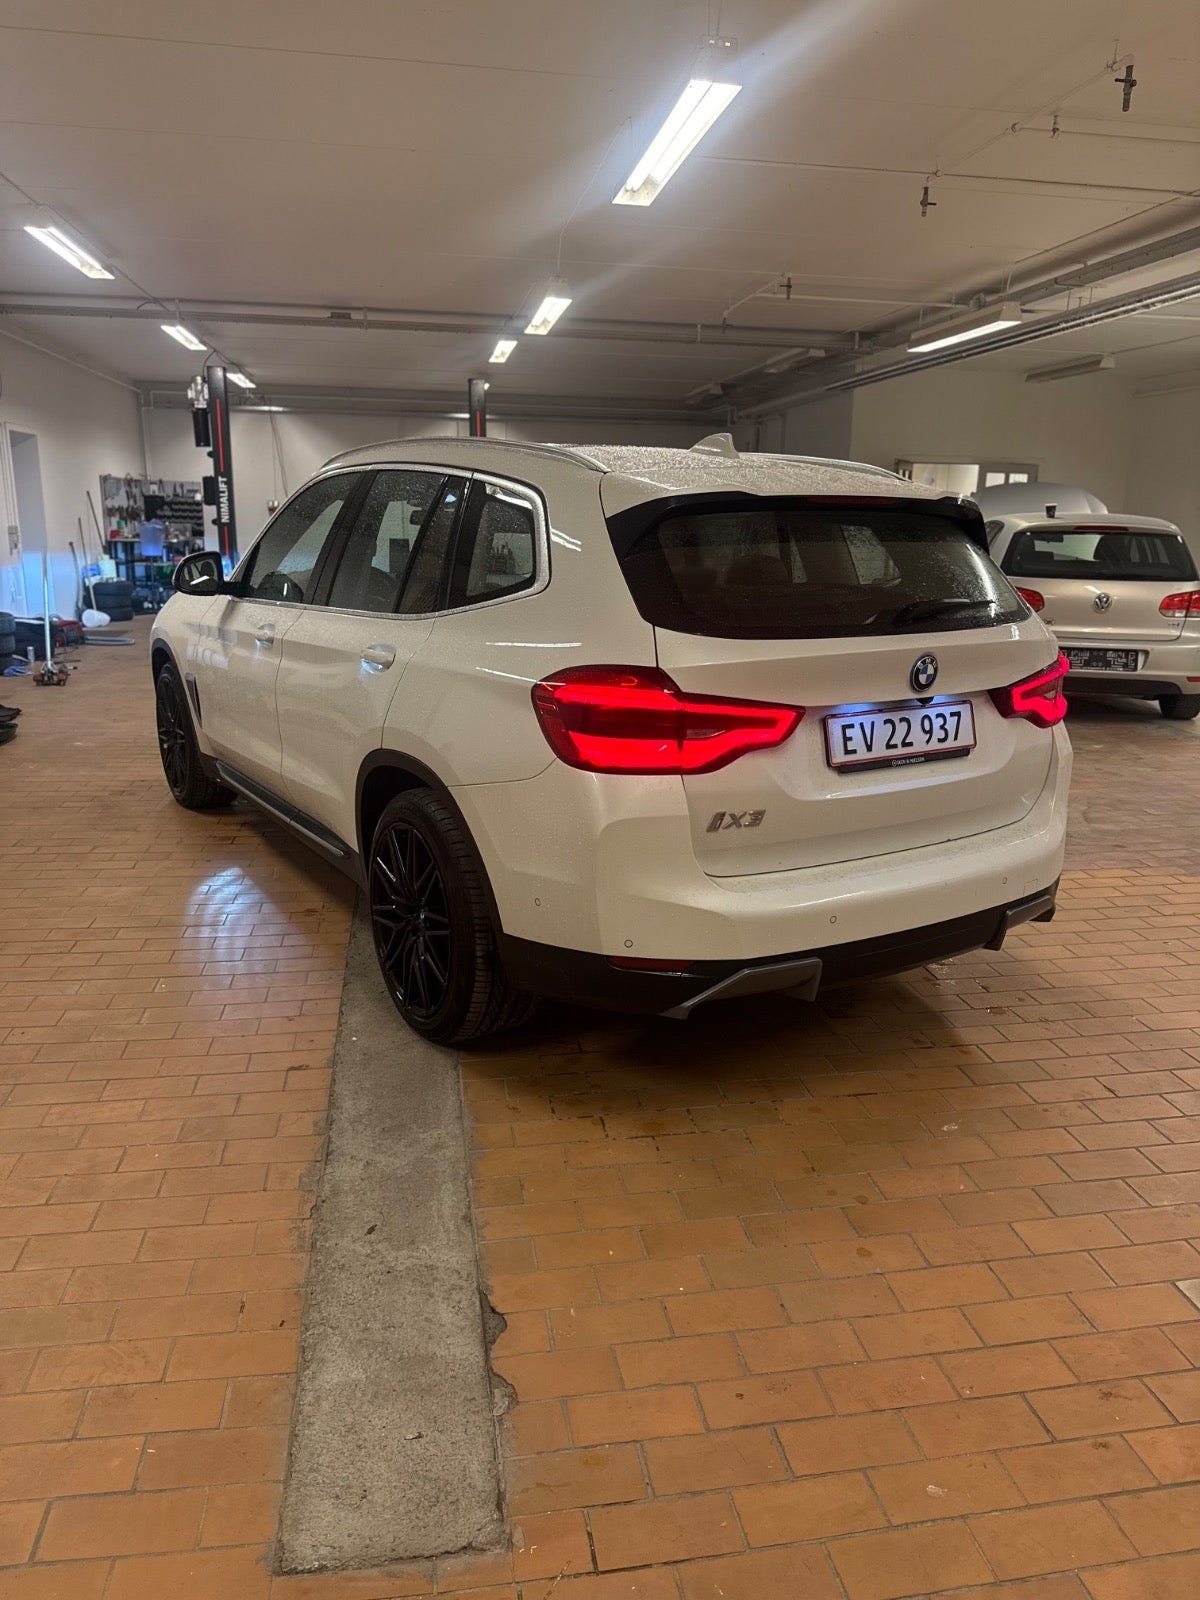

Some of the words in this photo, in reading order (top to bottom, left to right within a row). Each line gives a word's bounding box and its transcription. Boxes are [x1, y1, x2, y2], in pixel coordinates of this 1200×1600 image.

[218, 476, 230, 523] NIMALIFT
[841, 720, 875, 756] EV
[883, 716, 914, 750] 22
[920, 711, 962, 745] 937
